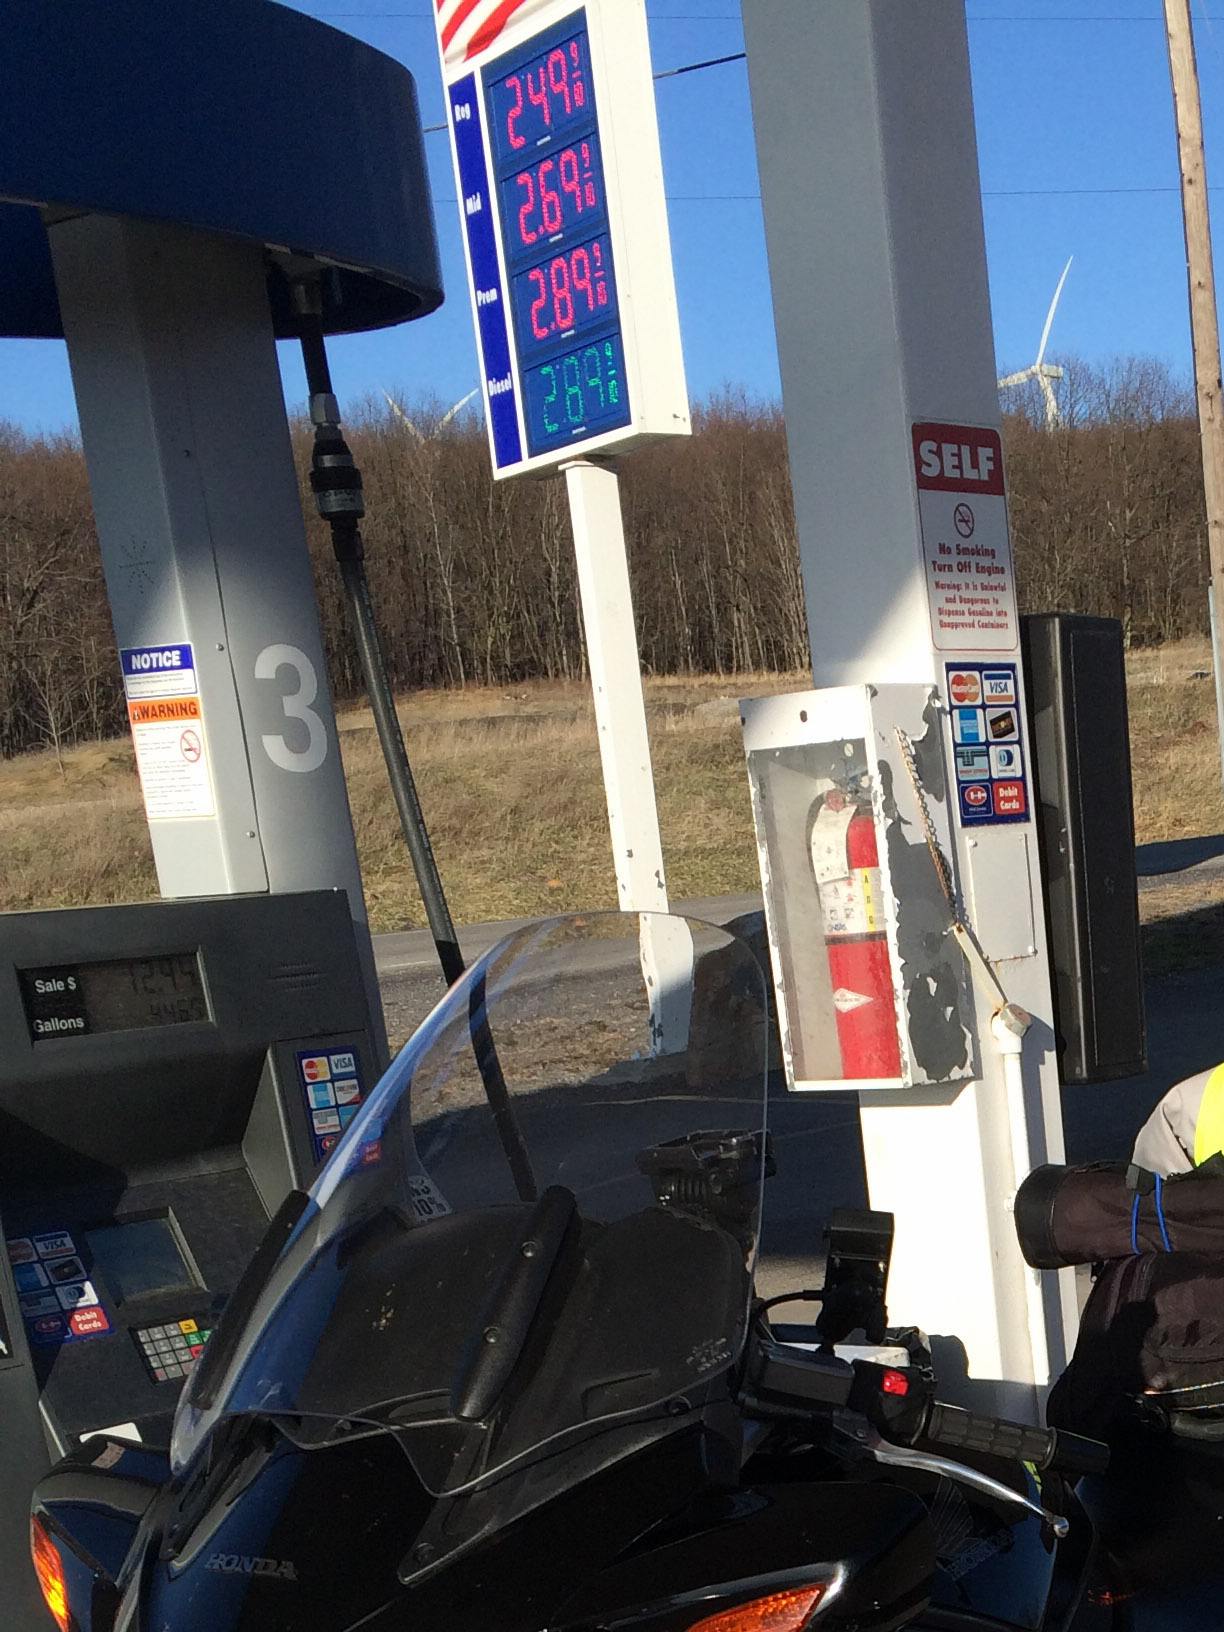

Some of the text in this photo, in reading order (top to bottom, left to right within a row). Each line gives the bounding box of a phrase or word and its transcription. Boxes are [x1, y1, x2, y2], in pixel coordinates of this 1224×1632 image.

[455, 103, 471, 121] Reg
[466, 192, 482, 215] Mid
[477, 288, 498, 307] Prem
[488, 372, 513, 396] Diesel
[919, 440, 994, 480] SELF
[938, 542, 996, 559] No Smoking
[931, 560, 1005, 576] Turn Off Engine
[131, 650, 182, 670] NOTICE
[989, 681, 1009, 694] VISA
[139, 701, 198, 720] WARNING
[254, 644, 328, 773] 3
[999, 786, 1018, 797] Debit
[1000, 799, 1020, 810] Cards
[34, 976, 77, 994] Sale $
[33, 1016, 85, 1033] Gallons
[333, 1057, 353, 1070] VISA
[44, 1238, 66, 1250] VISA
[74, 1311, 97, 1322] Debit
[78, 1320, 102, 1331] Cards
[205, 1553, 299, 1581] HONDA
